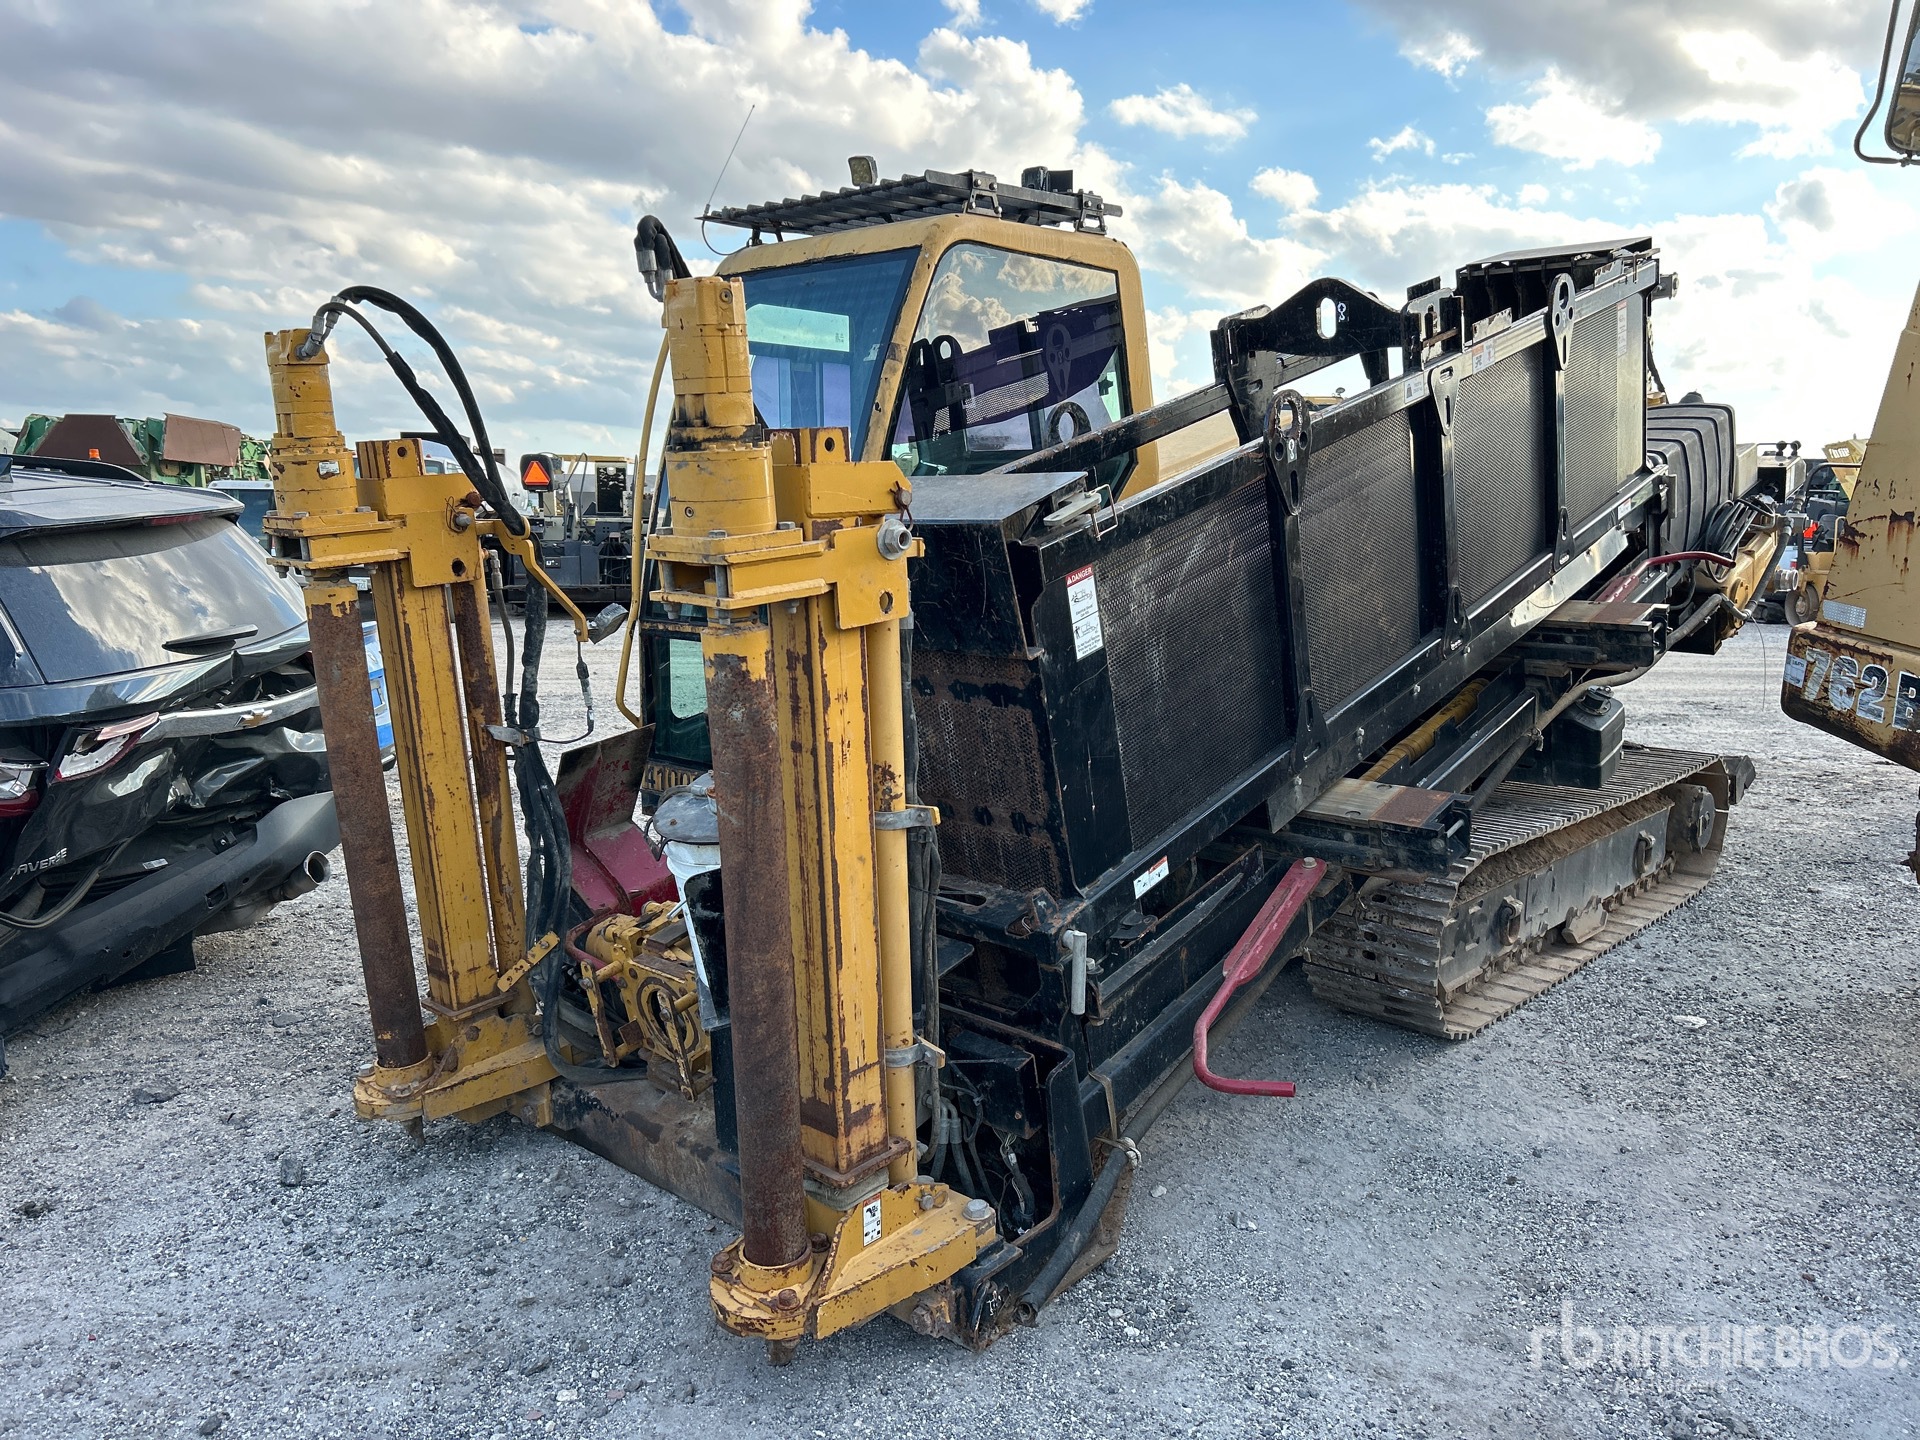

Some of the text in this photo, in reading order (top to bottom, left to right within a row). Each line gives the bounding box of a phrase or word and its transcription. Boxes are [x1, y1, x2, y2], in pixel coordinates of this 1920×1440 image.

[1071, 566, 1092, 582] DANGER
[1804, 647, 1920, 732] 762B
[14, 848, 67, 877] AVERSE
